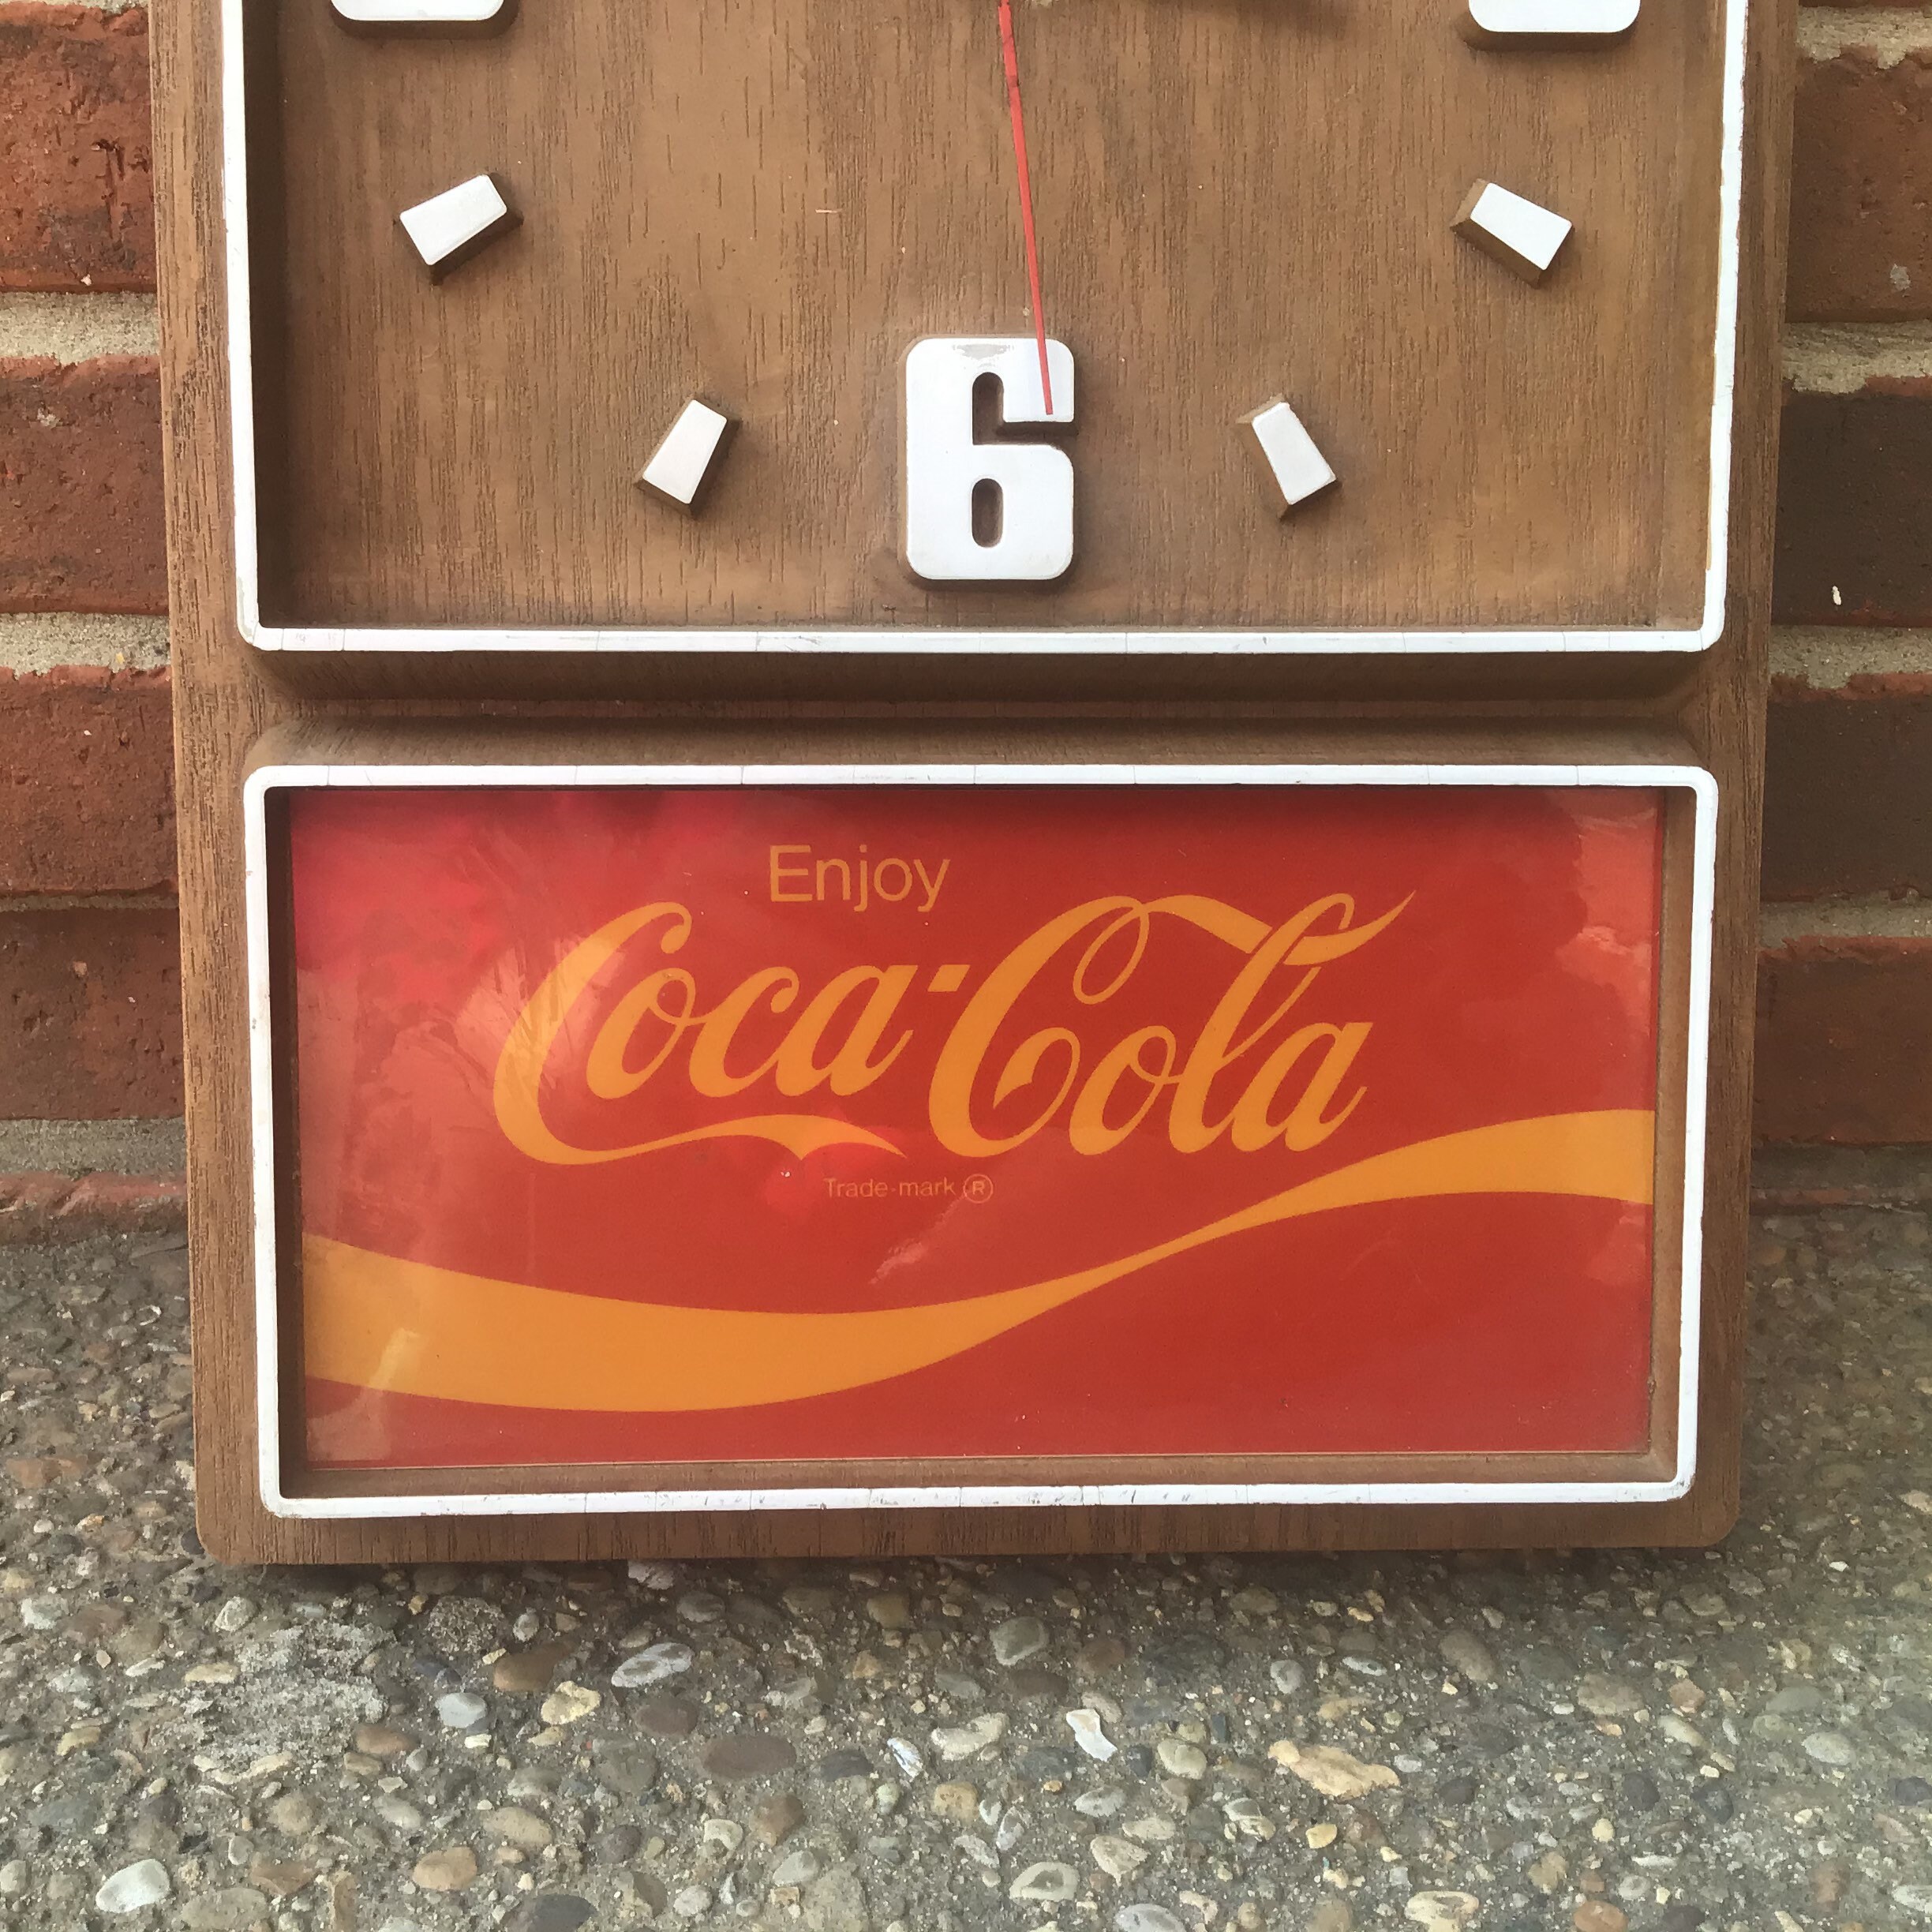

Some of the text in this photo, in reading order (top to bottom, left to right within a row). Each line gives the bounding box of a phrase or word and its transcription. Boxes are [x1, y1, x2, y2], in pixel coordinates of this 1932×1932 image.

[906, 337, 1075, 580] 6
[769, 844, 950, 912] Enjoy
[492, 889, 1417, 1166] Coca-Cola
[823, 1177, 957, 1198] Trade-mark
